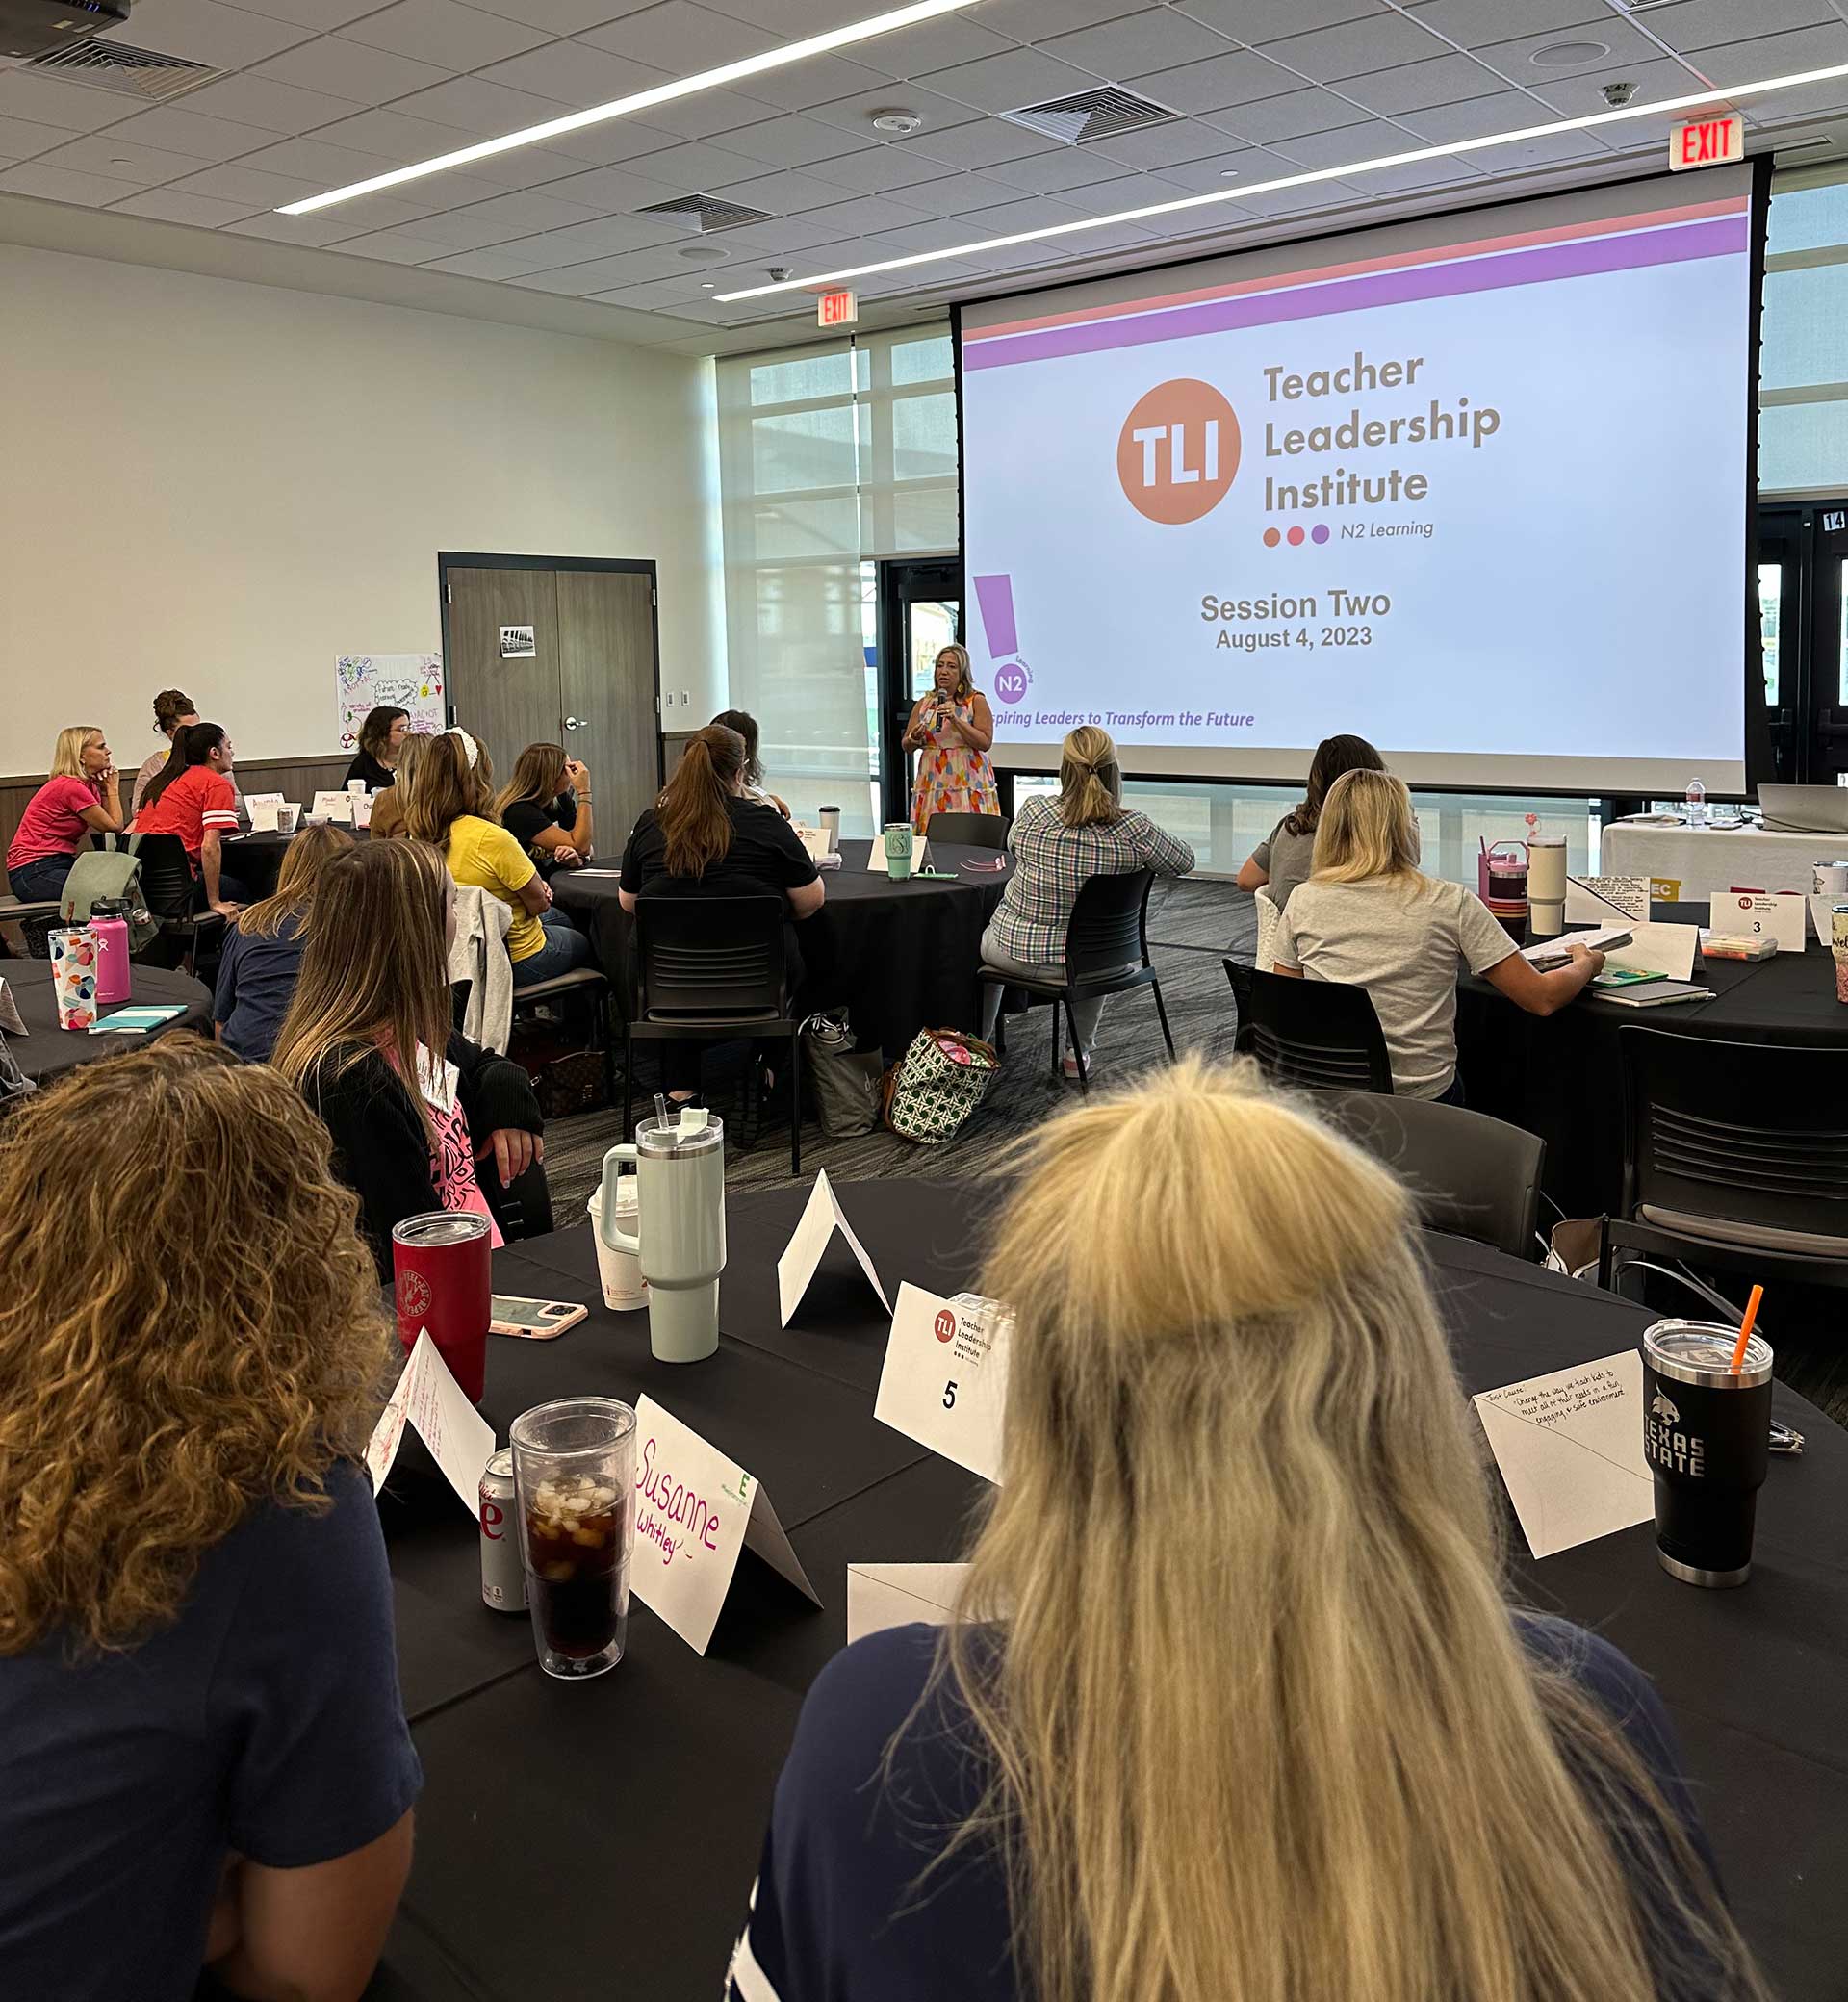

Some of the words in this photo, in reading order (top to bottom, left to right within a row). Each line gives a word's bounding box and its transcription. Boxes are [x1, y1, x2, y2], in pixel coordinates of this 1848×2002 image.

[1682, 119, 1732, 164] EXIT
[824, 293, 849, 322] EXIT
[1264, 352, 1424, 401] Teacher
[1265, 398, 1501, 457] Leadership
[1133, 420, 1219, 487] TLI
[1265, 468, 1428, 511] Institute
[1341, 524, 1365, 539] N2
[1371, 521, 1433, 539] Learning
[1201, 593, 1317, 621] Session
[1327, 589, 1391, 617] Two
[1217, 629, 1291, 653] August
[1296, 628, 1314, 651] 4,
[1321, 626, 1373, 647] 2023
[999, 676, 1022, 692] N2
[1036, 711, 1084, 725] Leaders
[1088, 711, 1101, 725] to
[1106, 711, 1175, 729] Transform
[1179, 711, 1202, 726] the
[1206, 712, 1255, 727] Future
[1753, 921, 1761, 933] 3
[937, 1316, 953, 1336] TLI
[961, 1317, 985, 1334] Teacher
[955, 1340, 980, 1358] Institute
[958, 1328, 992, 1353] Leadership
[942, 1380, 958, 1409] 5
[1645, 1413, 1704, 1457] TEXAS
[1645, 1435, 1705, 1477] STATE
[636, 1438, 719, 1551] Susanne
[636, 1508, 677, 1565] Whitley
